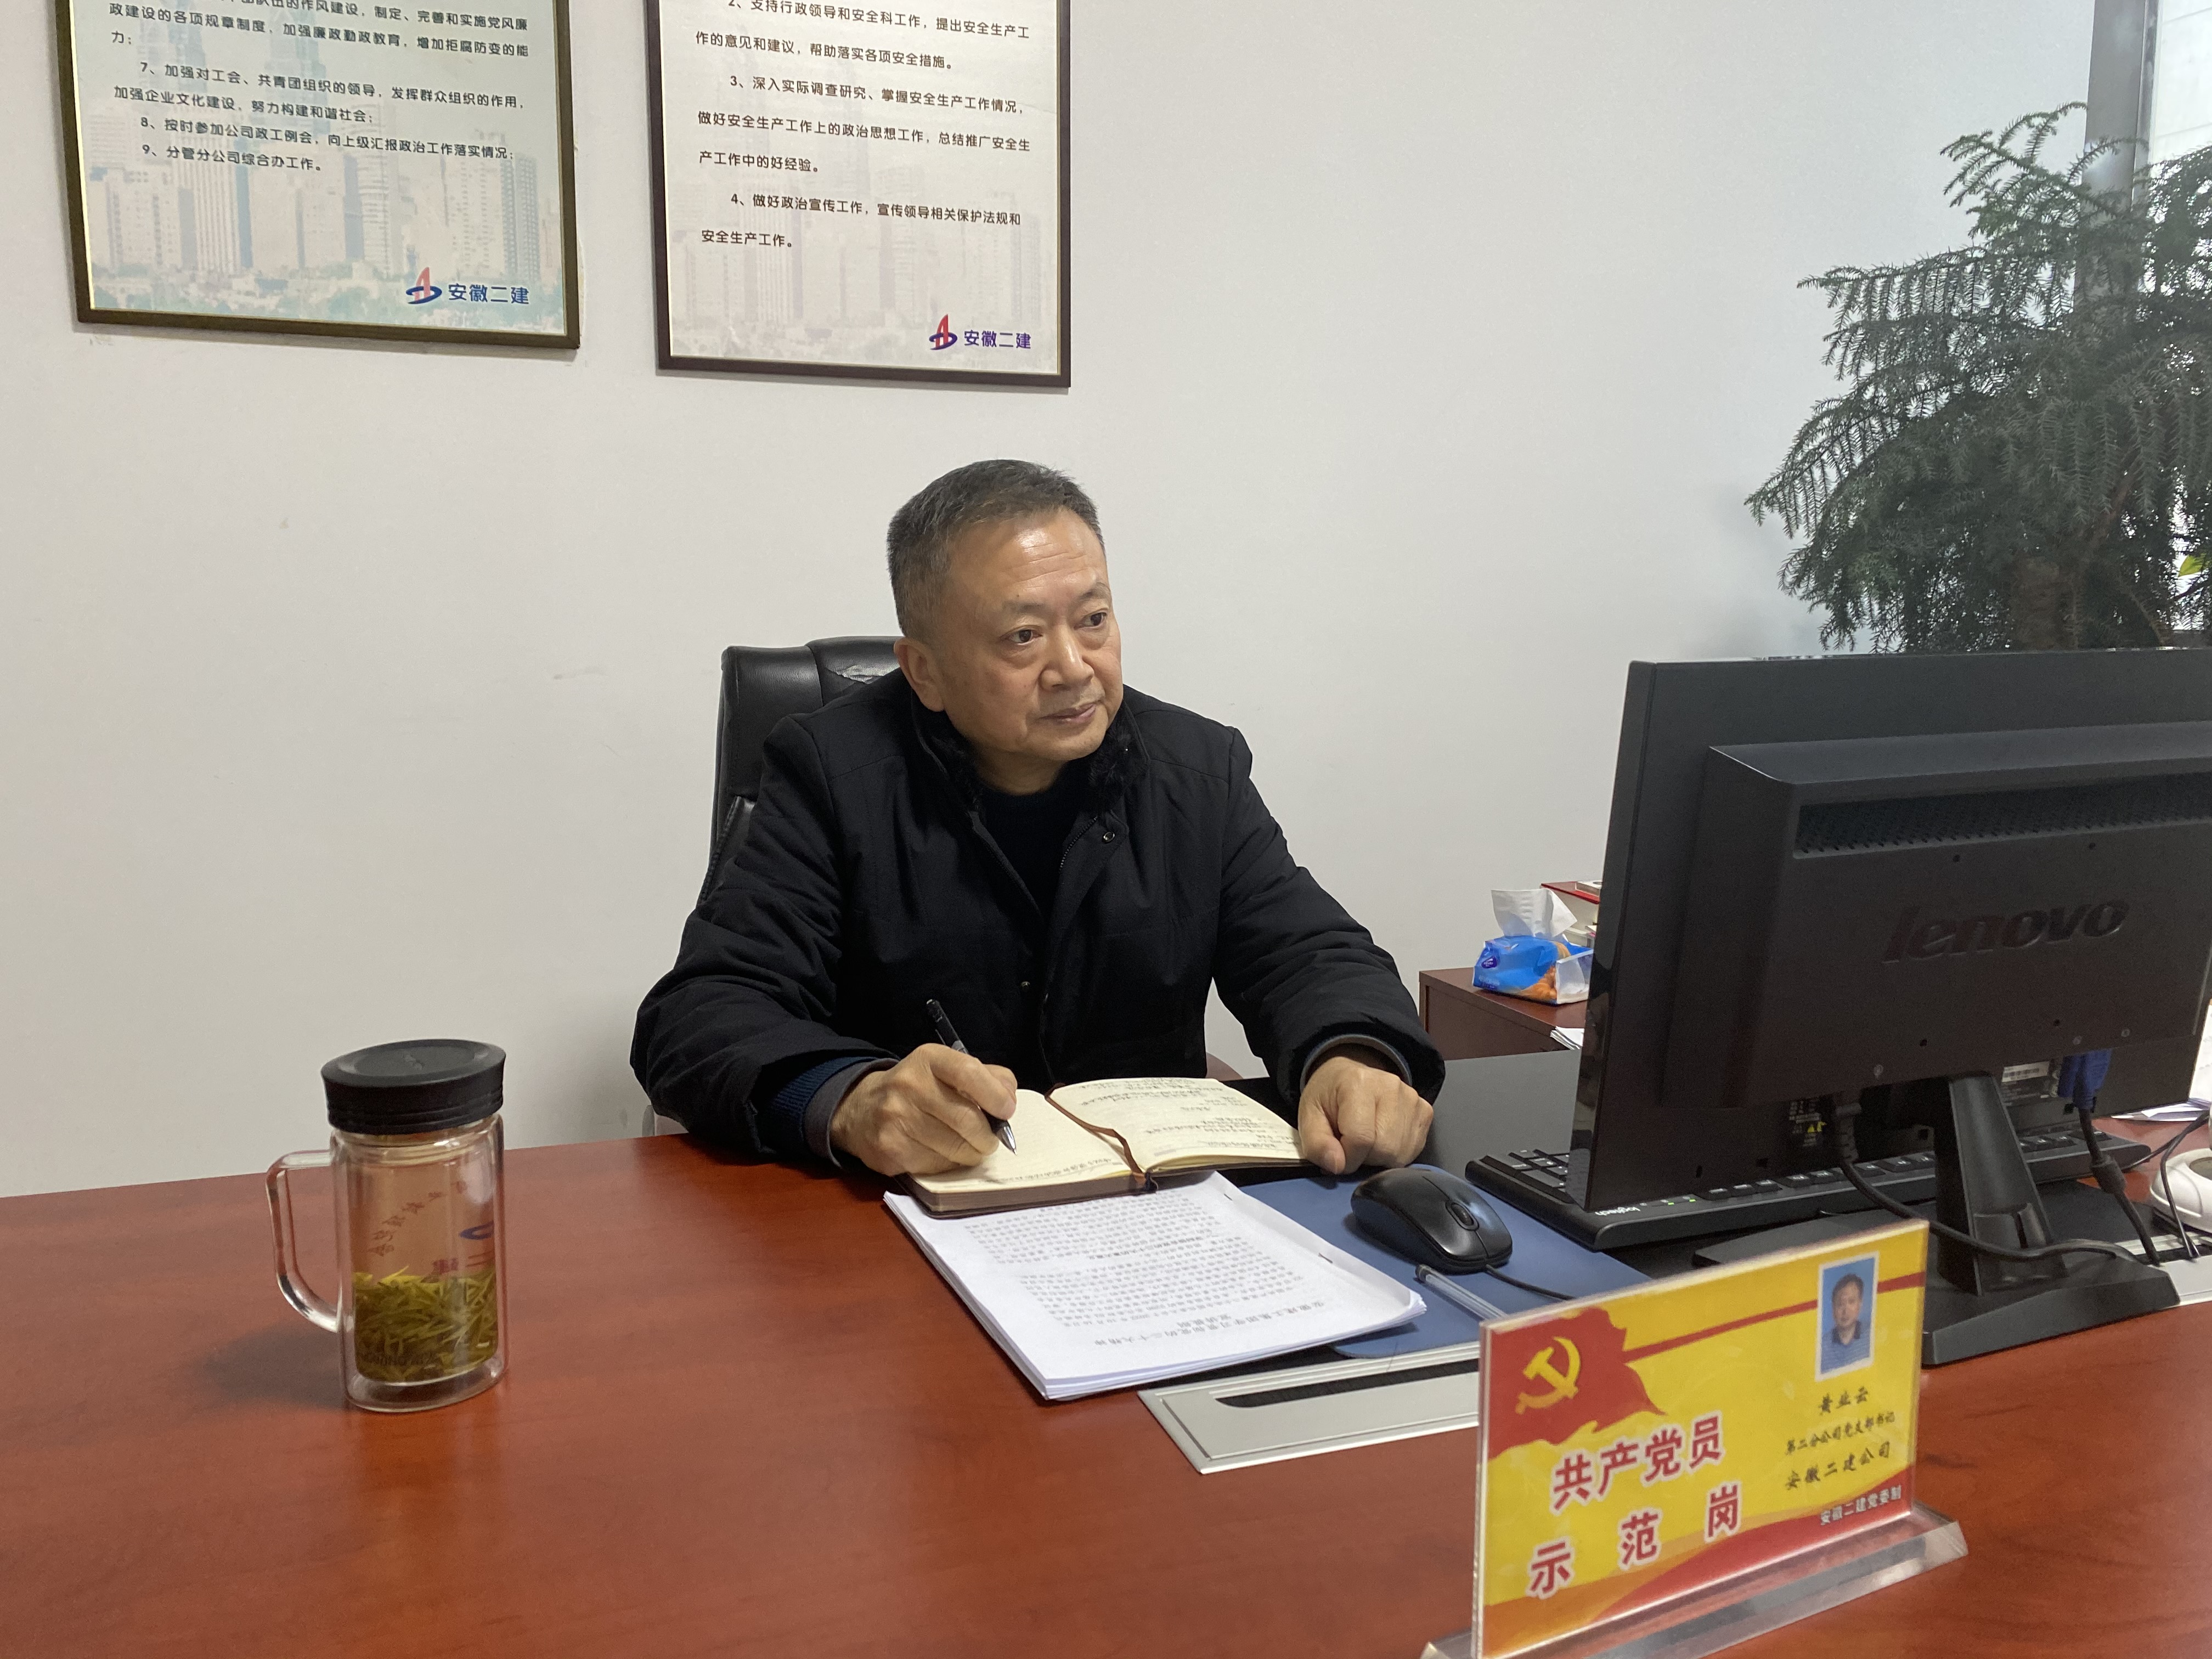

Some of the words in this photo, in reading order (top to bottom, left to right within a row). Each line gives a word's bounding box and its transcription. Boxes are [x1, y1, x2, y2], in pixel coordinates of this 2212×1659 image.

[696, 31, 951, 69] 作的意见和建议，帮助落实各项安全措施。
[730, 76, 1022, 114] 3、深入实际调查研究、掌握安全生产工作情况，
[698, 111, 1030, 151] 做好安全生产工作上的政治思想工作，总结推广安全生
[142, 144, 320, 171] 9、分管分公司综合办工作。
[699, 151, 818, 172] 产工作中的好经验。
[731, 194, 1020, 225] 4、做好政治宣传工作，宣传领导相关保护法规和
[702, 230, 792, 247] 安全生产工作。
[448, 283, 529, 304] 安徽二建
[964, 330, 1031, 349] 安徽二建
[1881, 899, 2130, 964] lenovo
[1595, 1206, 1641, 1216] logitech
[1553, 1414, 1723, 1511] 共产党员
[1785, 1441, 1890, 1490] 安徽二建公司
